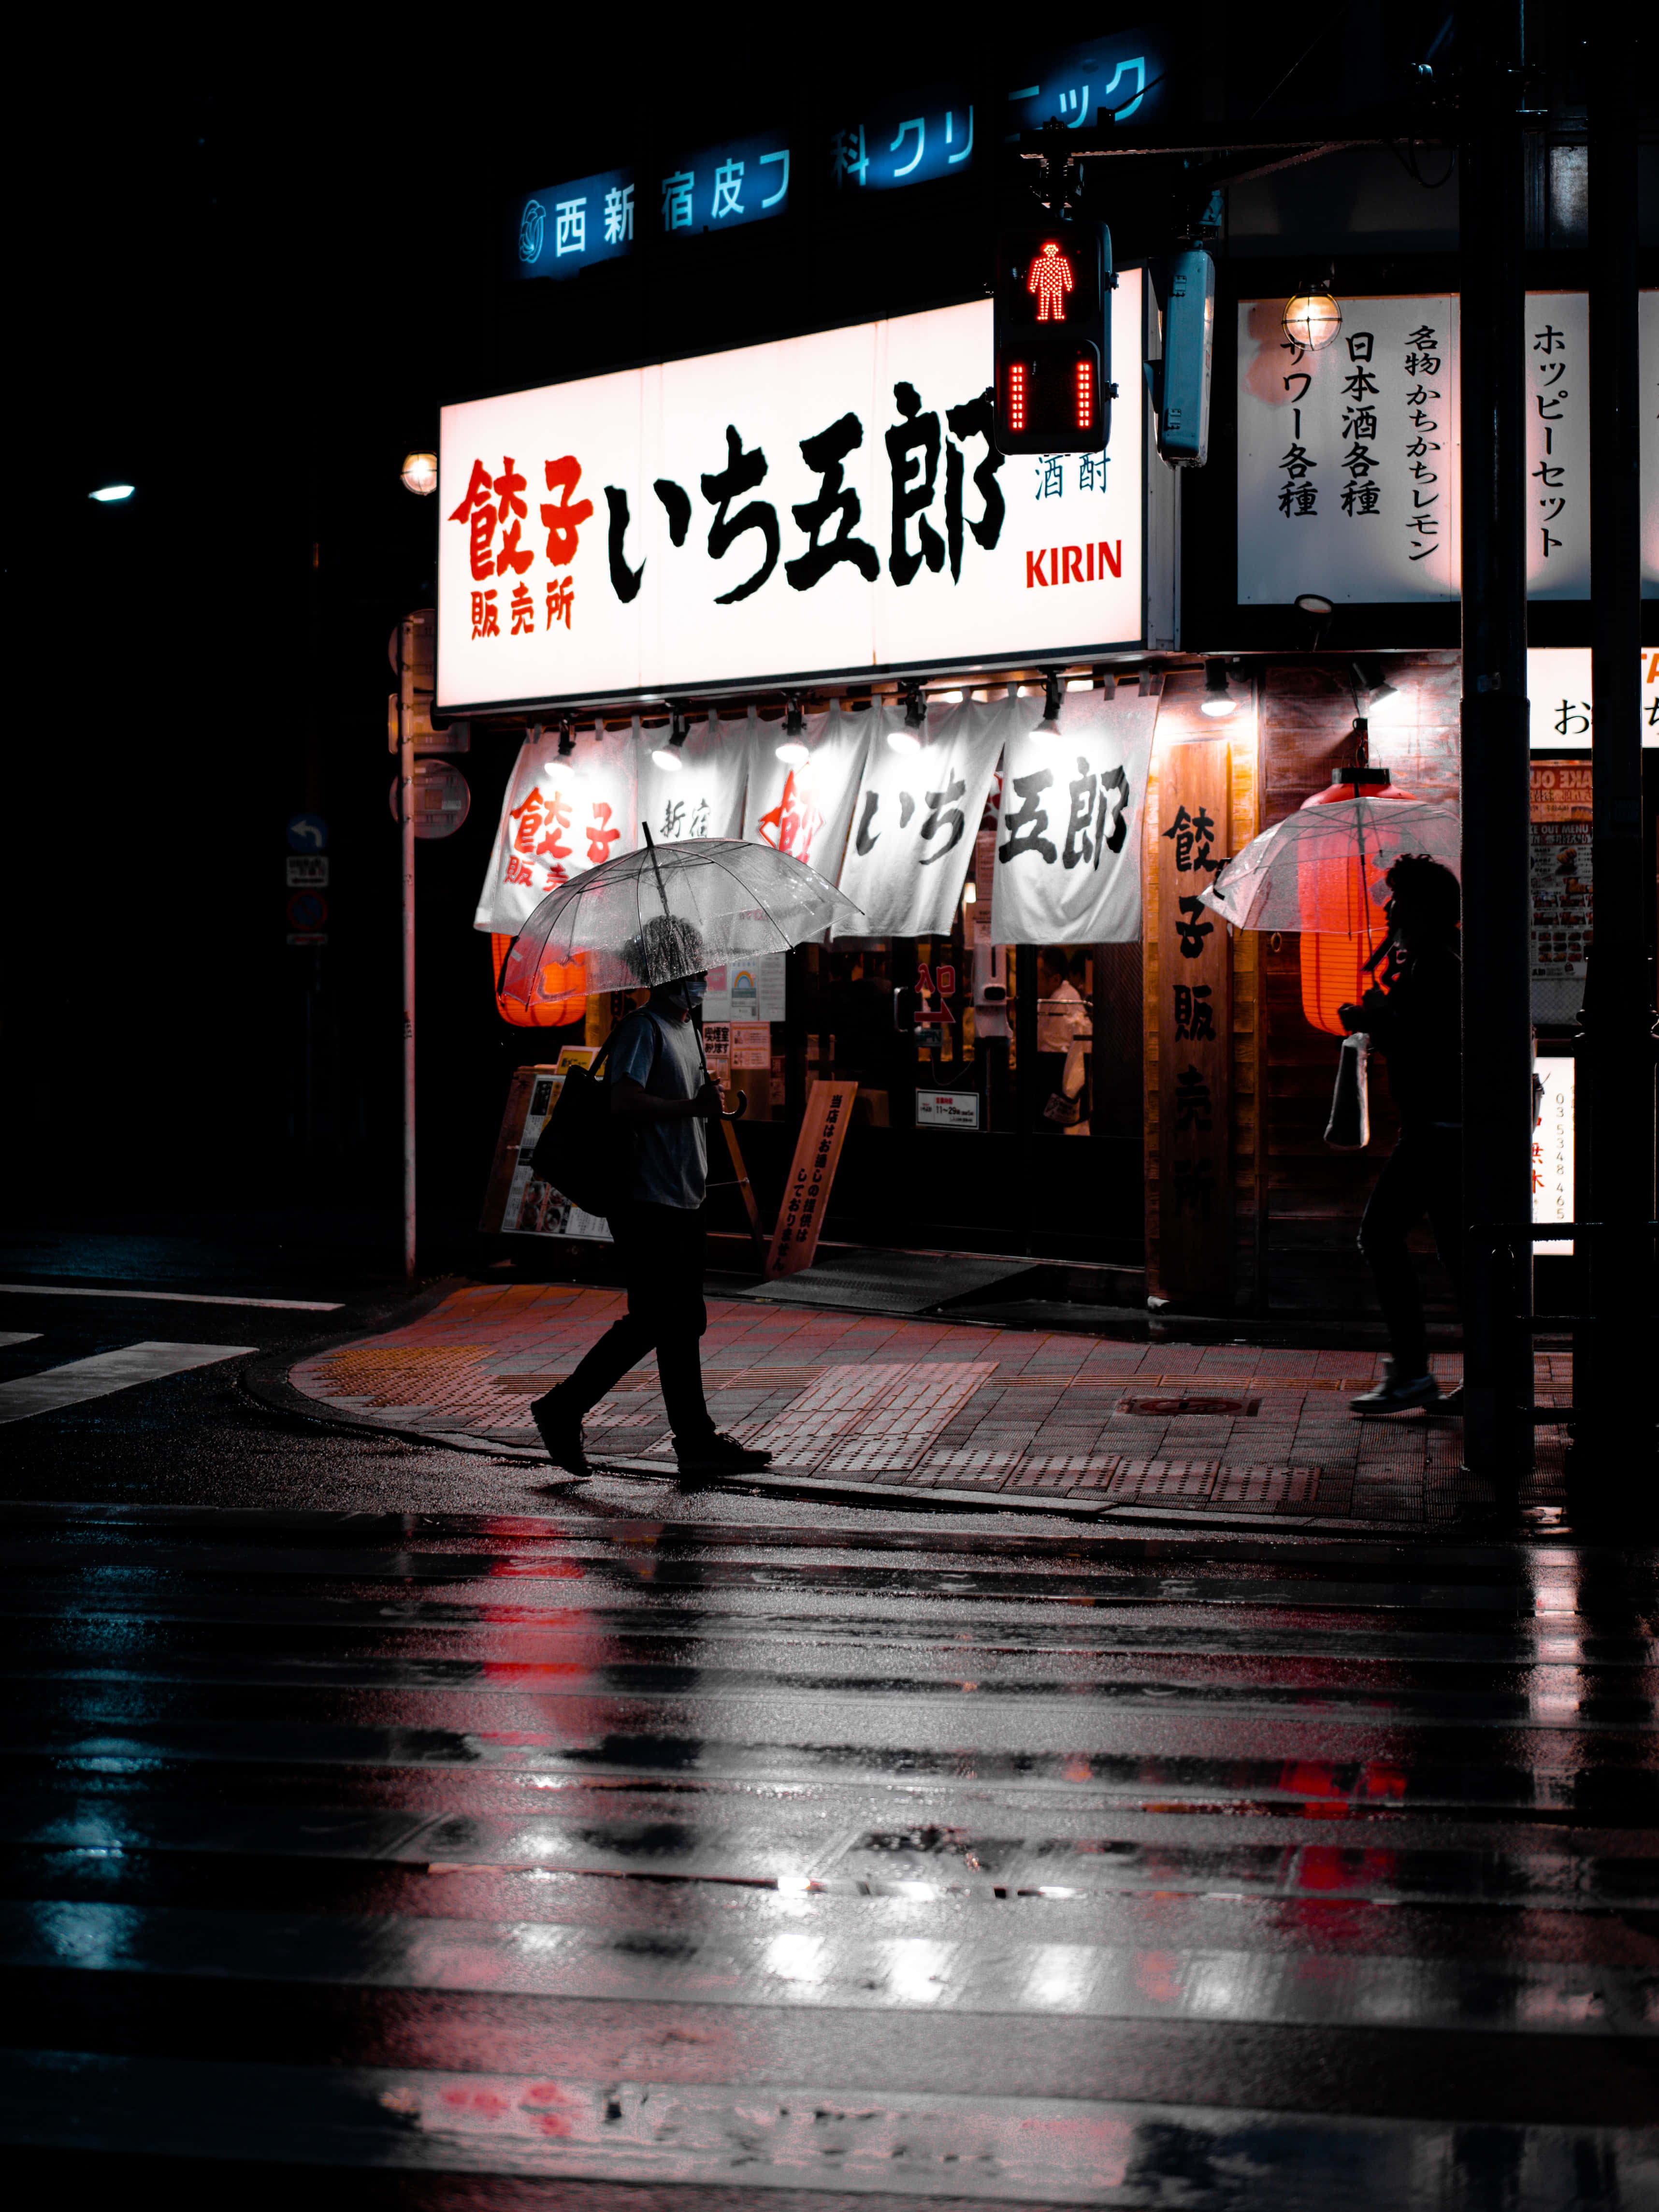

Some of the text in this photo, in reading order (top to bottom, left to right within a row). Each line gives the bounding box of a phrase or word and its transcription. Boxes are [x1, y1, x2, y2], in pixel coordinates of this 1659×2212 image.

[1340, 332, 1381, 518] 日本酒各種
[1531, 325, 1568, 557] ホッピーセット
[447, 456, 594, 581] 餃子
[604, 381, 1006, 605] いち五郎
[1026, 539, 1122, 588] KIRIN
[471, 575, 575, 640] 販売所
[510, 786, 620, 864] 餃子
[504, 855, 569, 892] 販売
[914, 963, 955, 994] 入口
